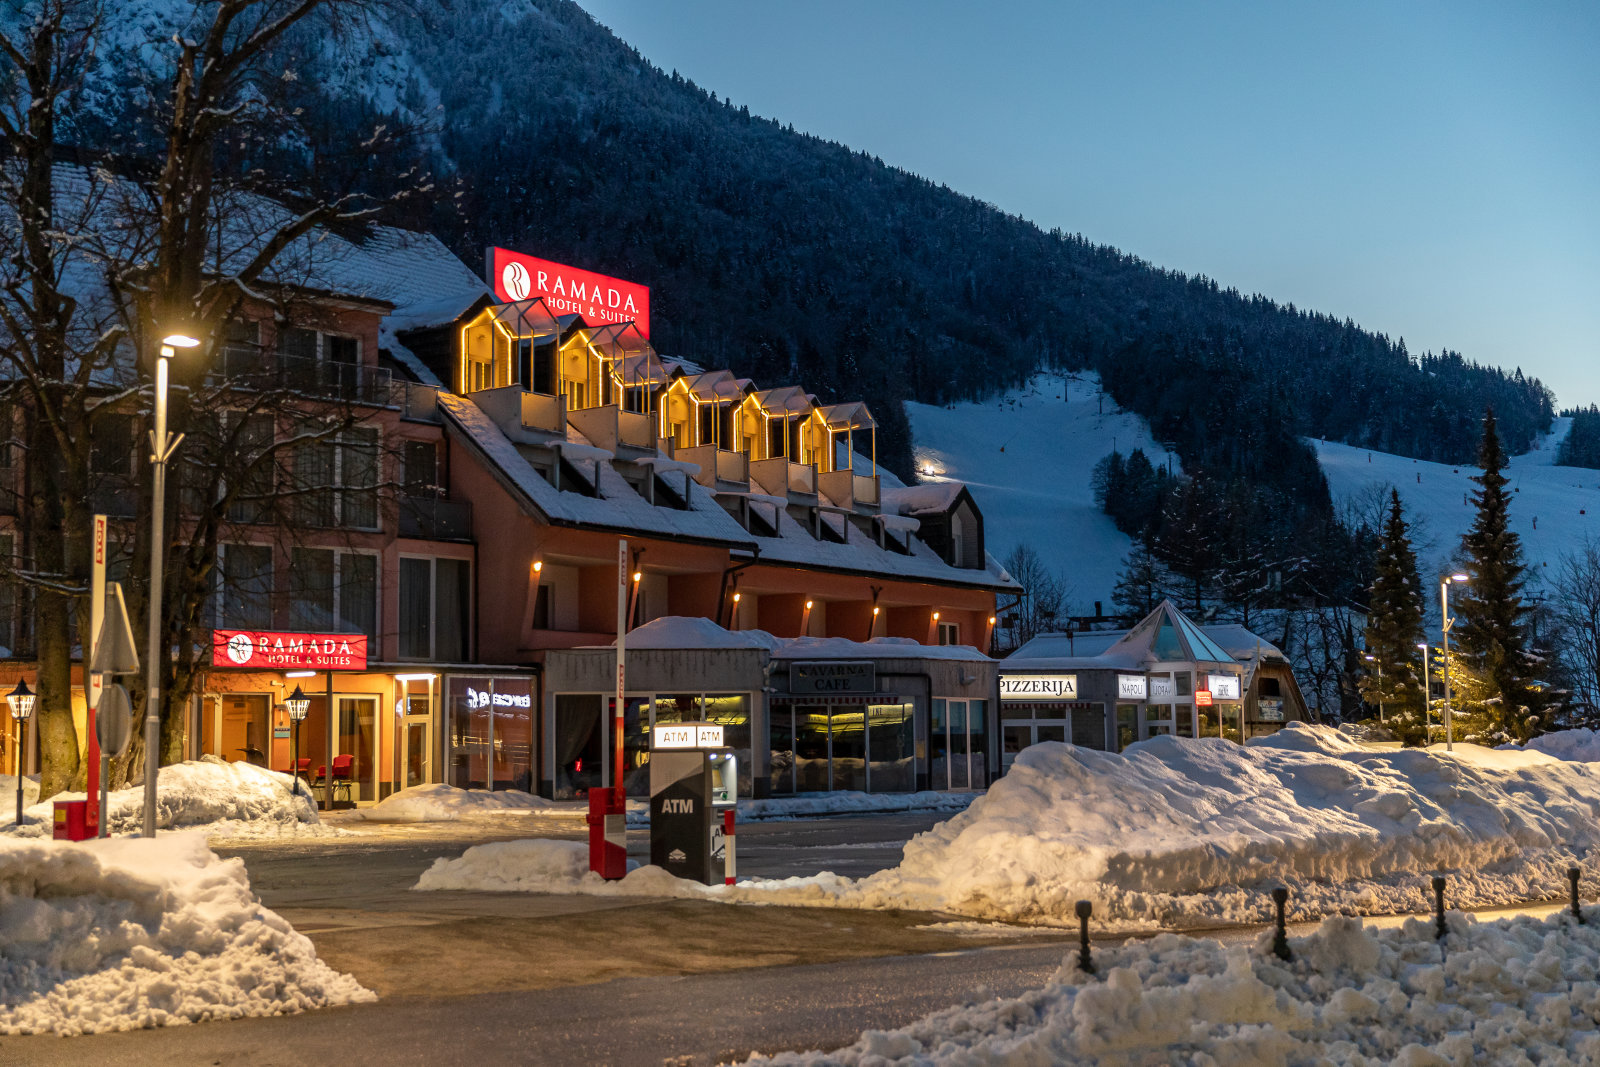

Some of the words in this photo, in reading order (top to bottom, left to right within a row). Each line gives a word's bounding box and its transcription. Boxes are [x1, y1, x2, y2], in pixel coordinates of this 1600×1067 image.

[548, 296, 583, 315] HOTEL
[589, 306, 596, 317] &
[96, 520, 104, 563] STOP
[268, 654, 301, 664] HOTEL
[316, 656, 351, 665] SUITES
[815, 679, 851, 690] CAFE
[999, 680, 1075, 696] PIZZERIJA
[1122, 683, 1143, 696] NAPOLI
[663, 732, 688, 742] ATM
[701, 731, 720, 741] ATM
[661, 798, 694, 814] ATM
